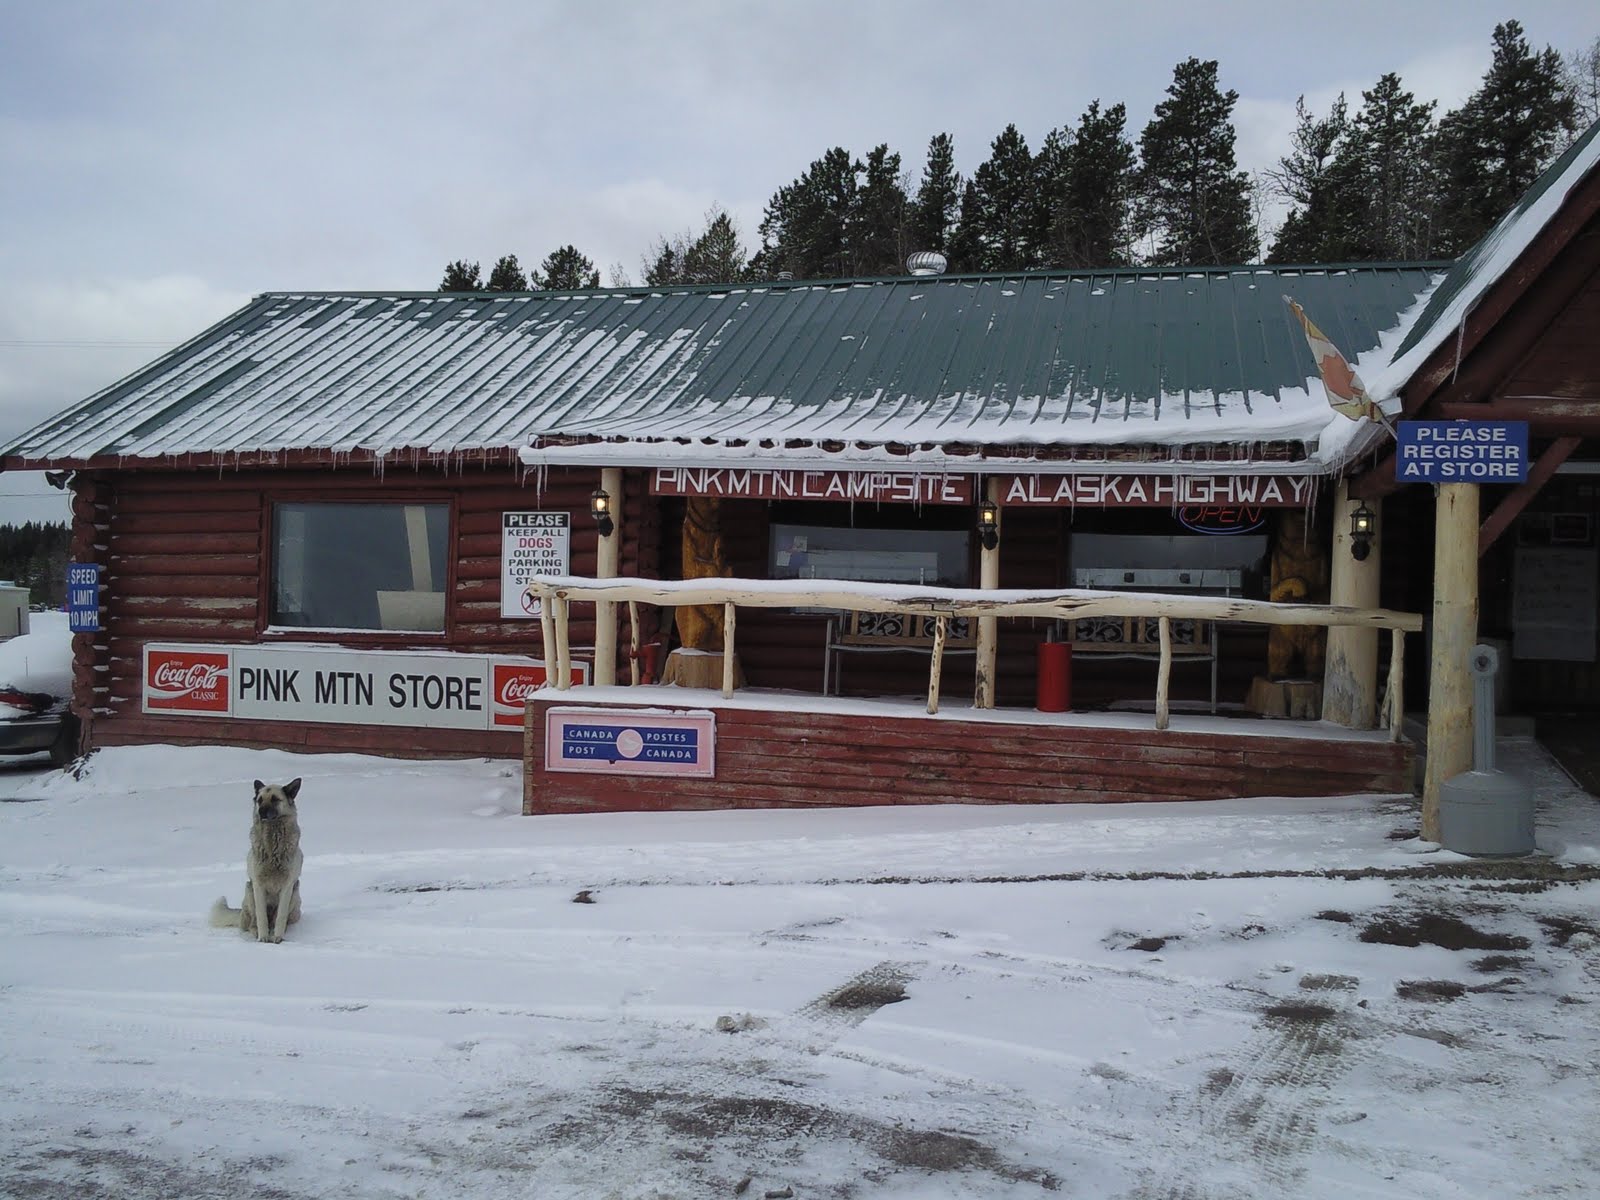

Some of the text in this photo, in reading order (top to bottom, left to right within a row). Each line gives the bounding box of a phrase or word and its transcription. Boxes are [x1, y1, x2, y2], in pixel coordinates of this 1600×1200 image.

[1417, 428, 1506, 441] PLEASE
[1403, 445, 1520, 459] REGISTER
[1404, 462, 1520, 476] AT STORE
[655, 468, 724, 495] PINK
[802, 471, 965, 502] CAMPSITE
[1005, 476, 1308, 503] ALASKA HIGHWAY
[1183, 504, 1264, 522] OPEN
[509, 515, 564, 526] PLEASE
[508, 529, 564, 537] KEEP ALL
[519, 538, 553, 549] DOGS
[513, 550, 558, 558] OUT OF
[508, 559, 562, 567] PARKING
[71, 568, 97, 585] SPEED
[509, 568, 561, 576] LOT AND
[73, 590, 94, 605] LIMIT
[70, 611, 99, 626] 10 MPH
[155, 662, 220, 689] Coca-Cola
[239, 667, 482, 711] PINK MTN STORE
[191, 690, 219, 701] CLASSIC
[569, 730, 613, 739] CANADA
[647, 733, 686, 742] POSTES
[569, 746, 595, 755] POST
[647, 749, 691, 759] CANADA
